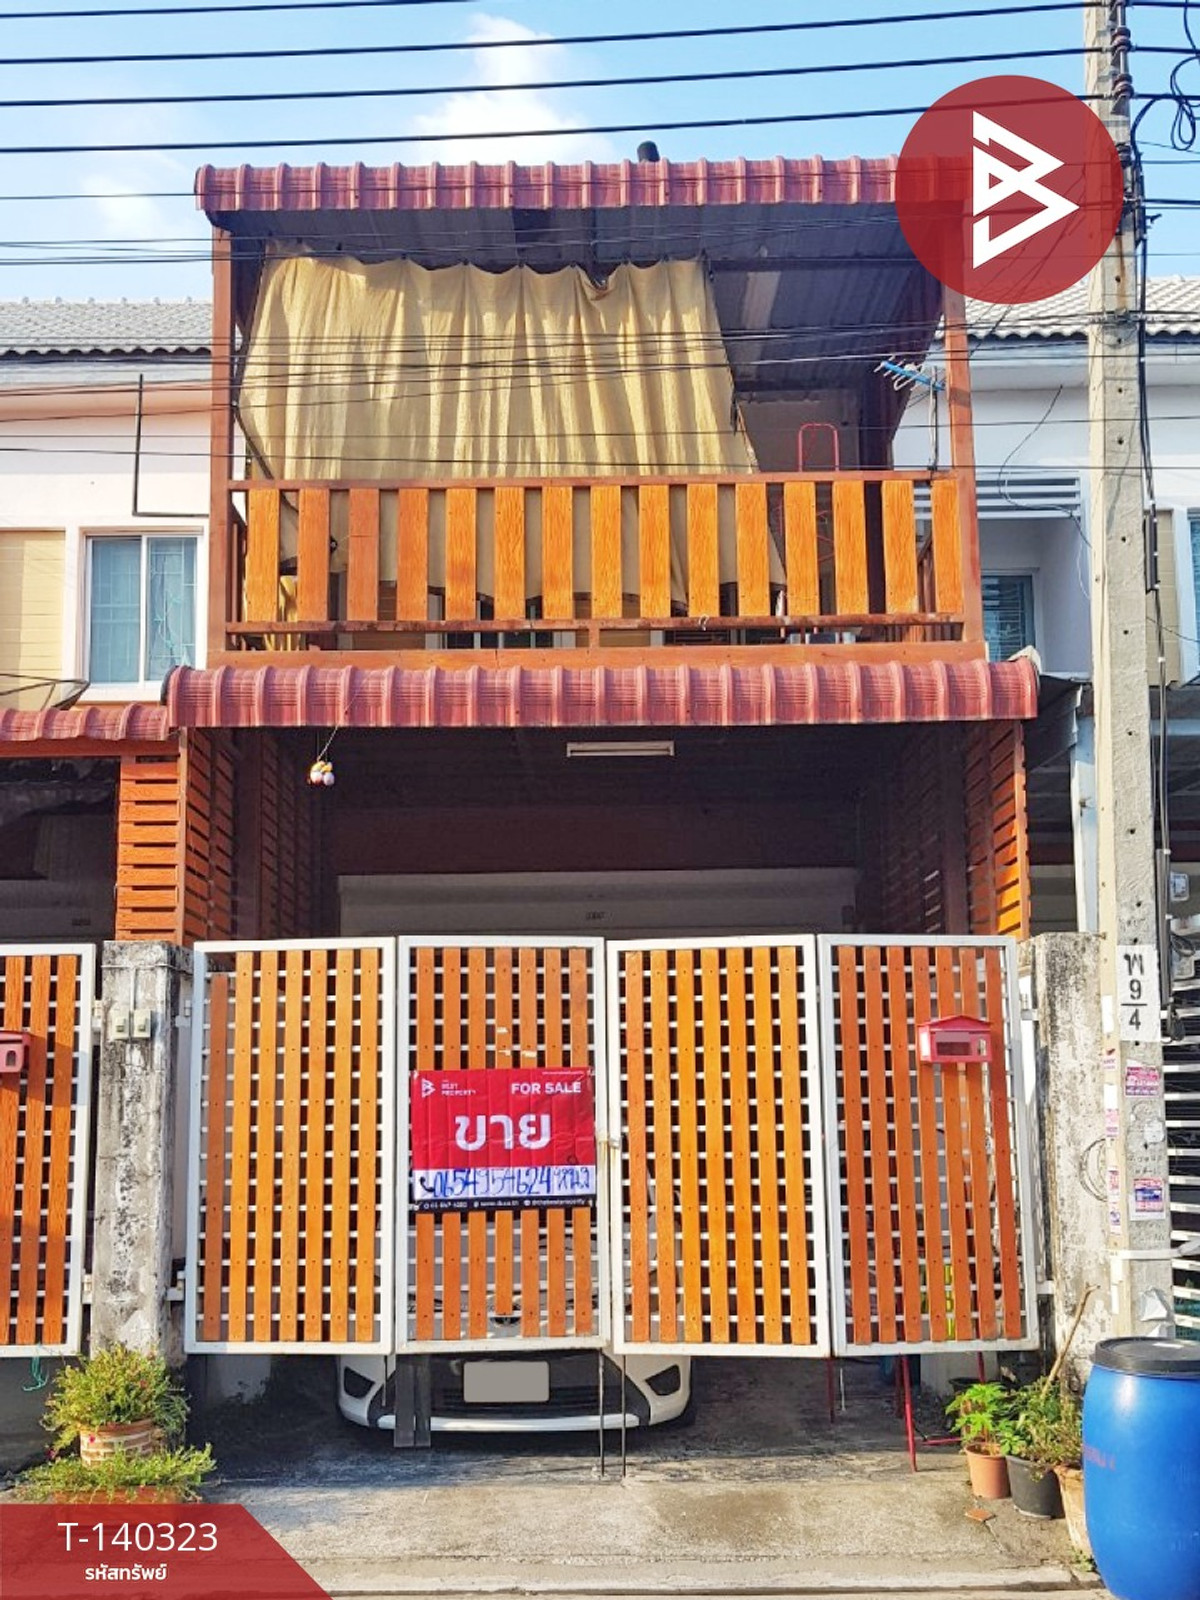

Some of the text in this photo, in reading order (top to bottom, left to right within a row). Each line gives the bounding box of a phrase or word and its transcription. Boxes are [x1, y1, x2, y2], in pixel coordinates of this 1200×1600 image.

[1129, 979, 1141, 1000] 9
[1128, 1008, 1142, 1031] 4
[511, 1081, 582, 1095] FOR SALE
[455, 1114, 551, 1151] ขาย
